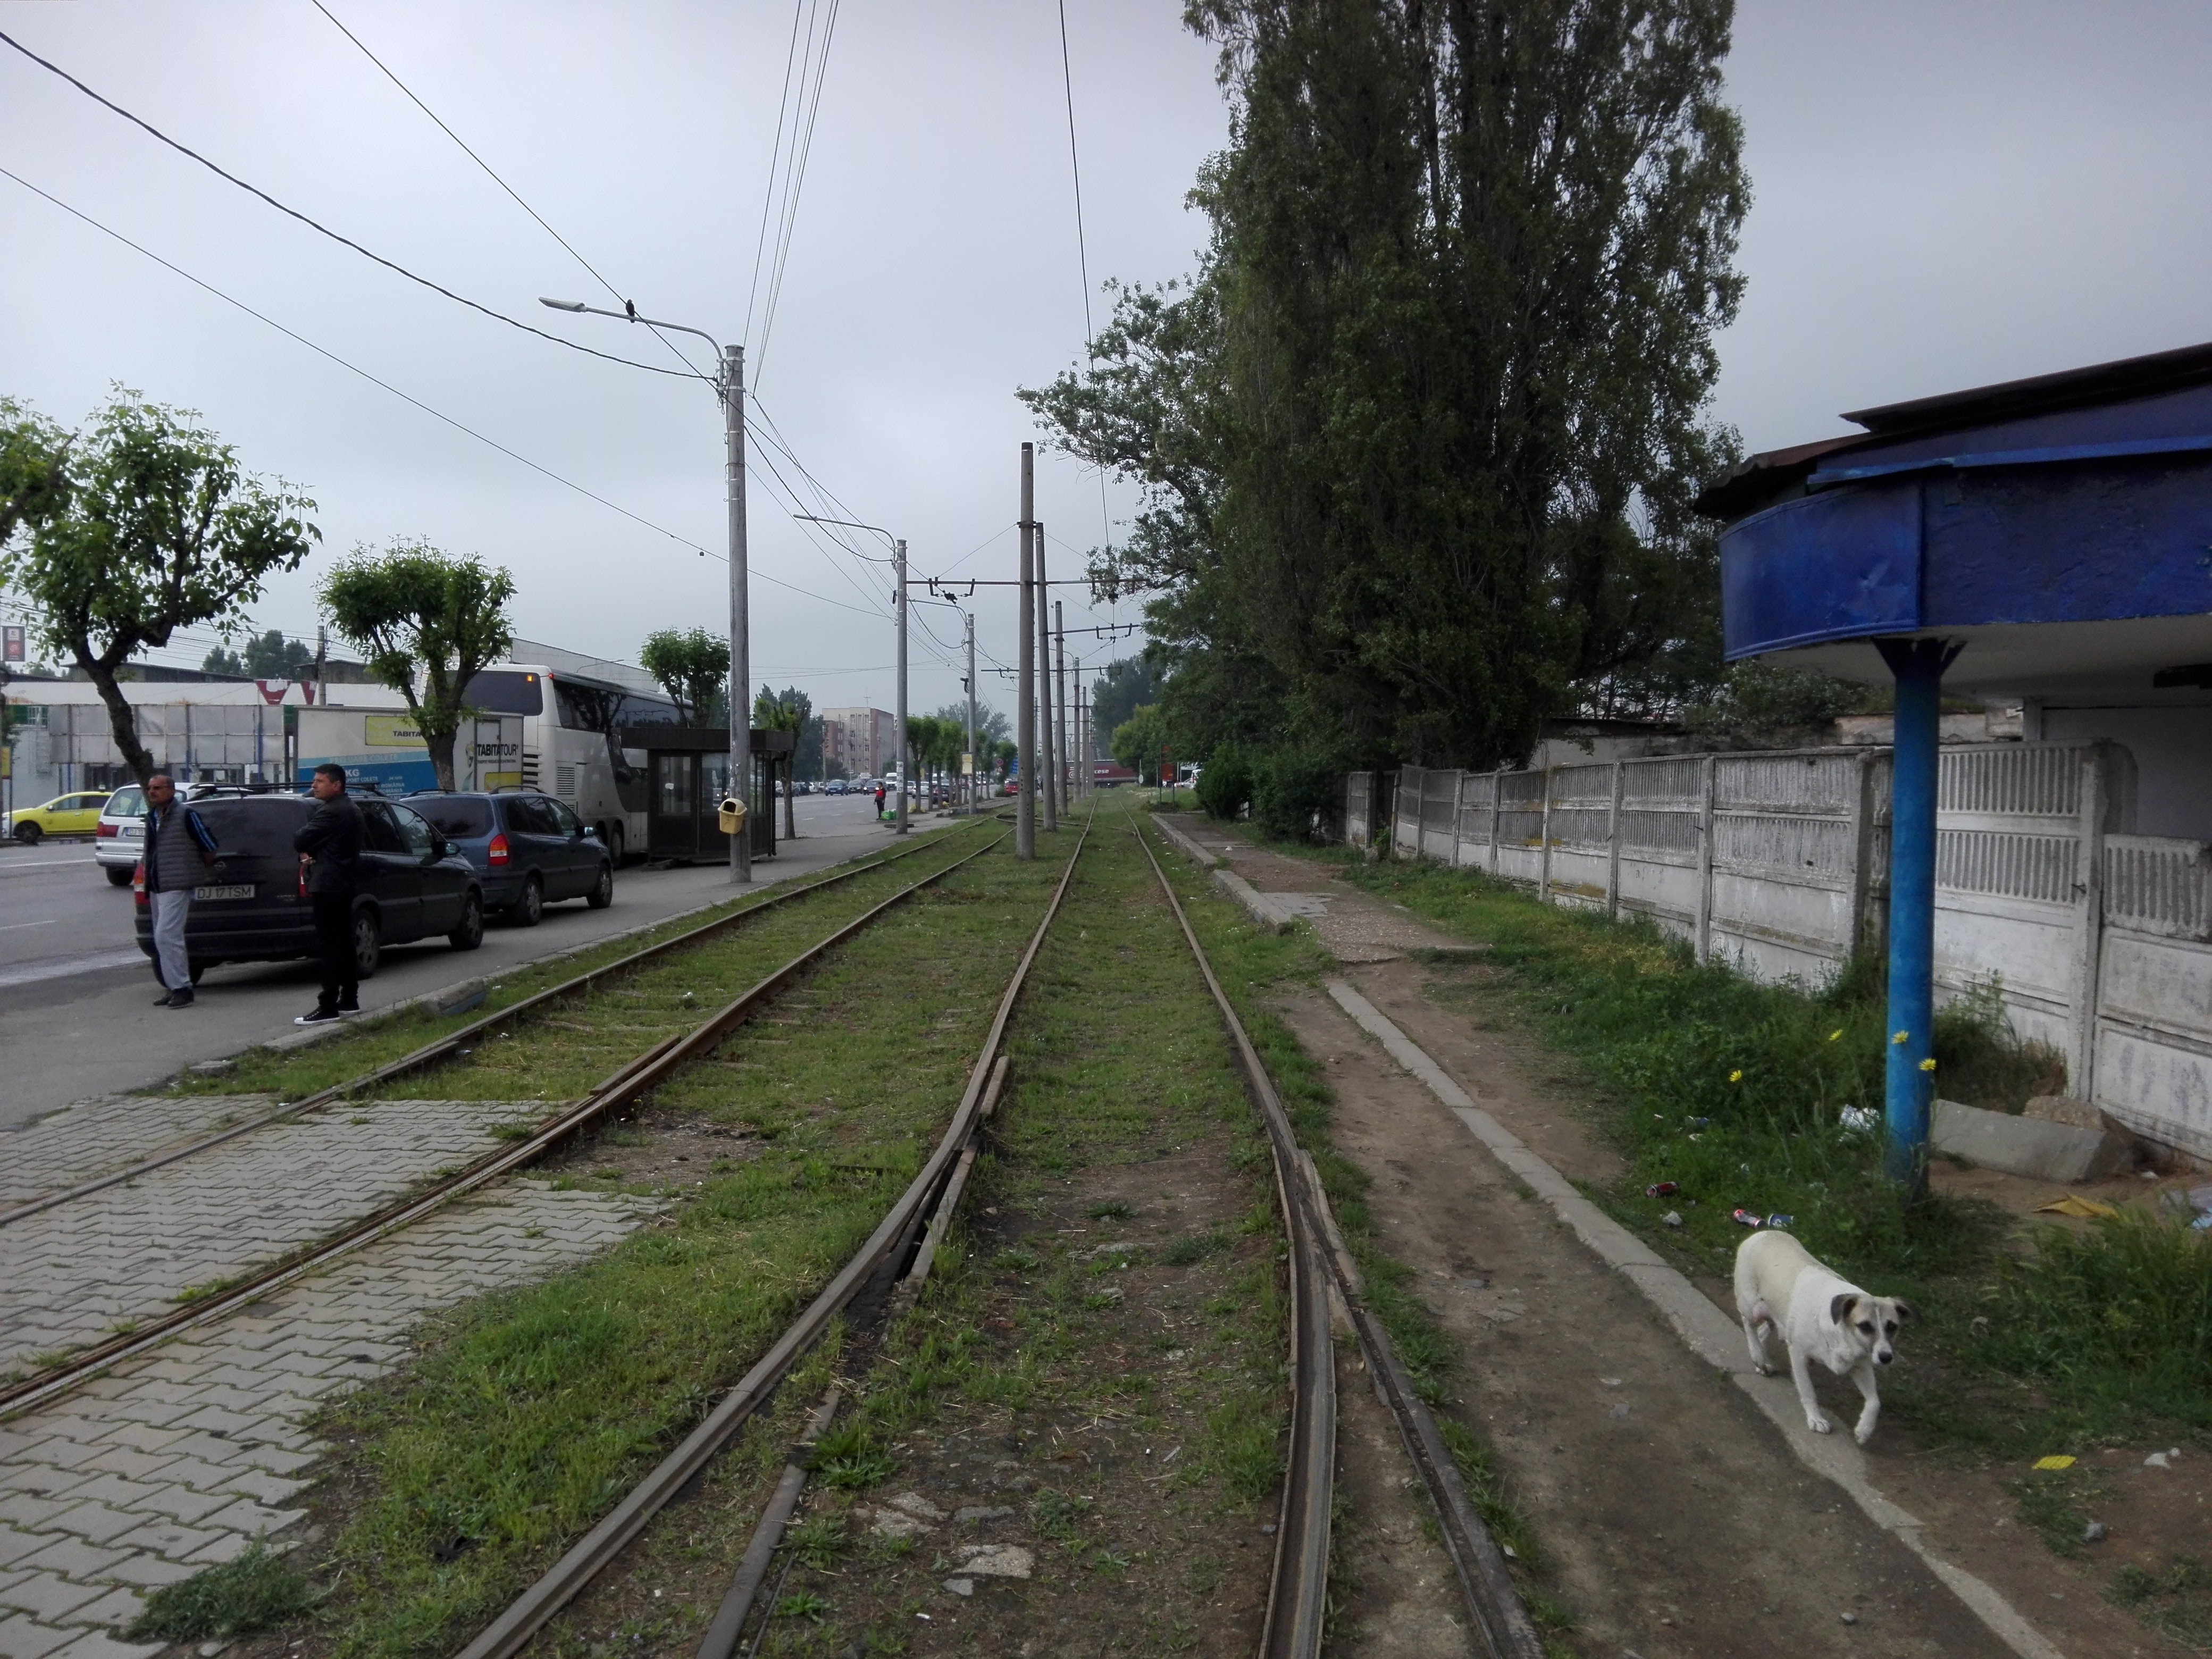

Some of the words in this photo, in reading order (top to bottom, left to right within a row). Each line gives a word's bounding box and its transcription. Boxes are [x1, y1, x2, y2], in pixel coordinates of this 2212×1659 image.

[197, 888, 212, 899] DJ
[215, 887, 225, 897] 17
[228, 887, 251, 898] TSM
